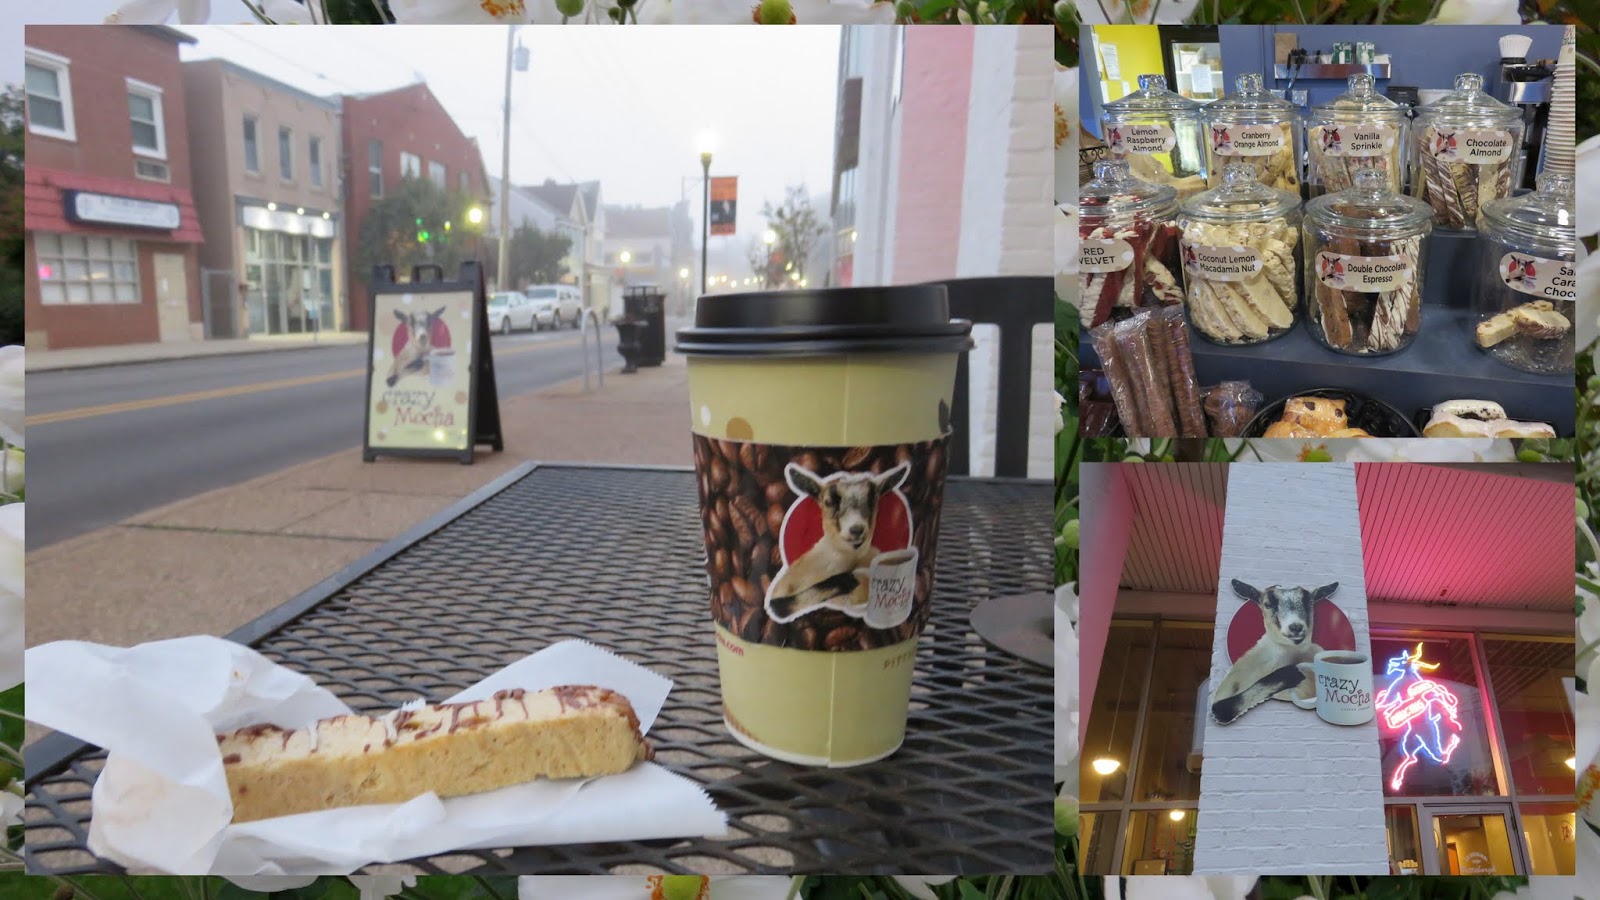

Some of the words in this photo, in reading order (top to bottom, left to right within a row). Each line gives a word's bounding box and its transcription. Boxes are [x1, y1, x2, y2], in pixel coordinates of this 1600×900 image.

[1131, 128, 1158, 136] Lemon
[1241, 132, 1271, 141] Cranberry
[1354, 132, 1380, 141] Vanilla
[1126, 136, 1166, 145] Raspberry
[1233, 140, 1256, 150] Orange
[1257, 139, 1279, 148] Almond
[1466, 138, 1507, 147] Chocolate
[1132, 144, 1163, 152] Almond
[1350, 141, 1383, 151] Sprinkle
[1470, 147, 1502, 156] Almond
[1083, 247, 1105, 256] RED
[1198, 253, 1228, 263] Coconut
[1229, 254, 1256, 263] Lemon
[1199, 263, 1240, 274] Macadamia
[1242, 263, 1256, 272] Nut
[1347, 262, 1374, 273] Double
[1375, 262, 1407, 273] Chocolate
[1362, 274, 1393, 284] Espresso
[1544, 287, 1574, 298] Choc
[393, 404, 455, 428] Mocha
[1318, 674, 1359, 695] crazy
[1325, 688, 1371, 707] Mocha
